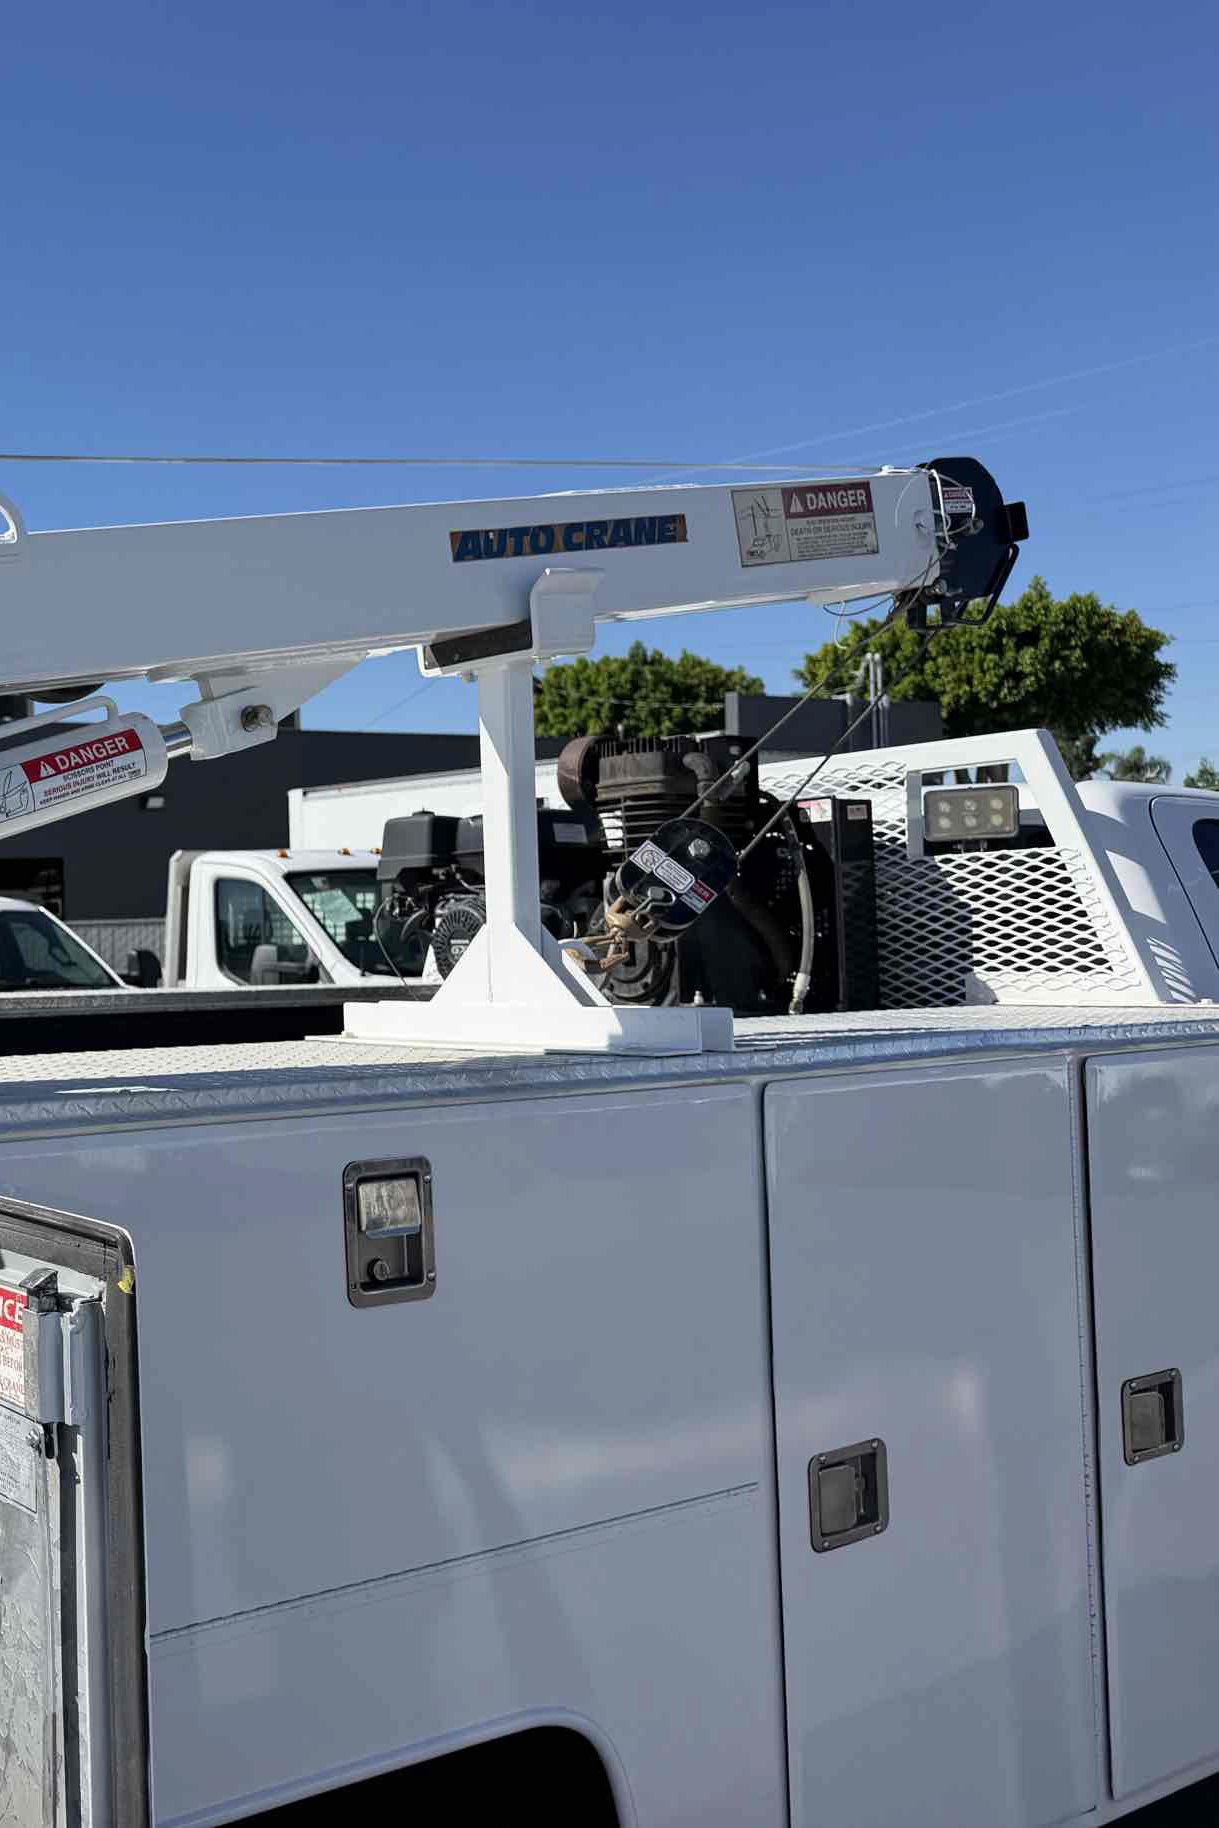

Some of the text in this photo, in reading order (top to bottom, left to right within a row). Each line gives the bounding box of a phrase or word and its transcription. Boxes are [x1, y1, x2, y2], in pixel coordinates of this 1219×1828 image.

[806, 488, 867, 511] DANGER
[454, 514, 679, 562] AUTO CRANE
[55, 736, 130, 770] DANGER
